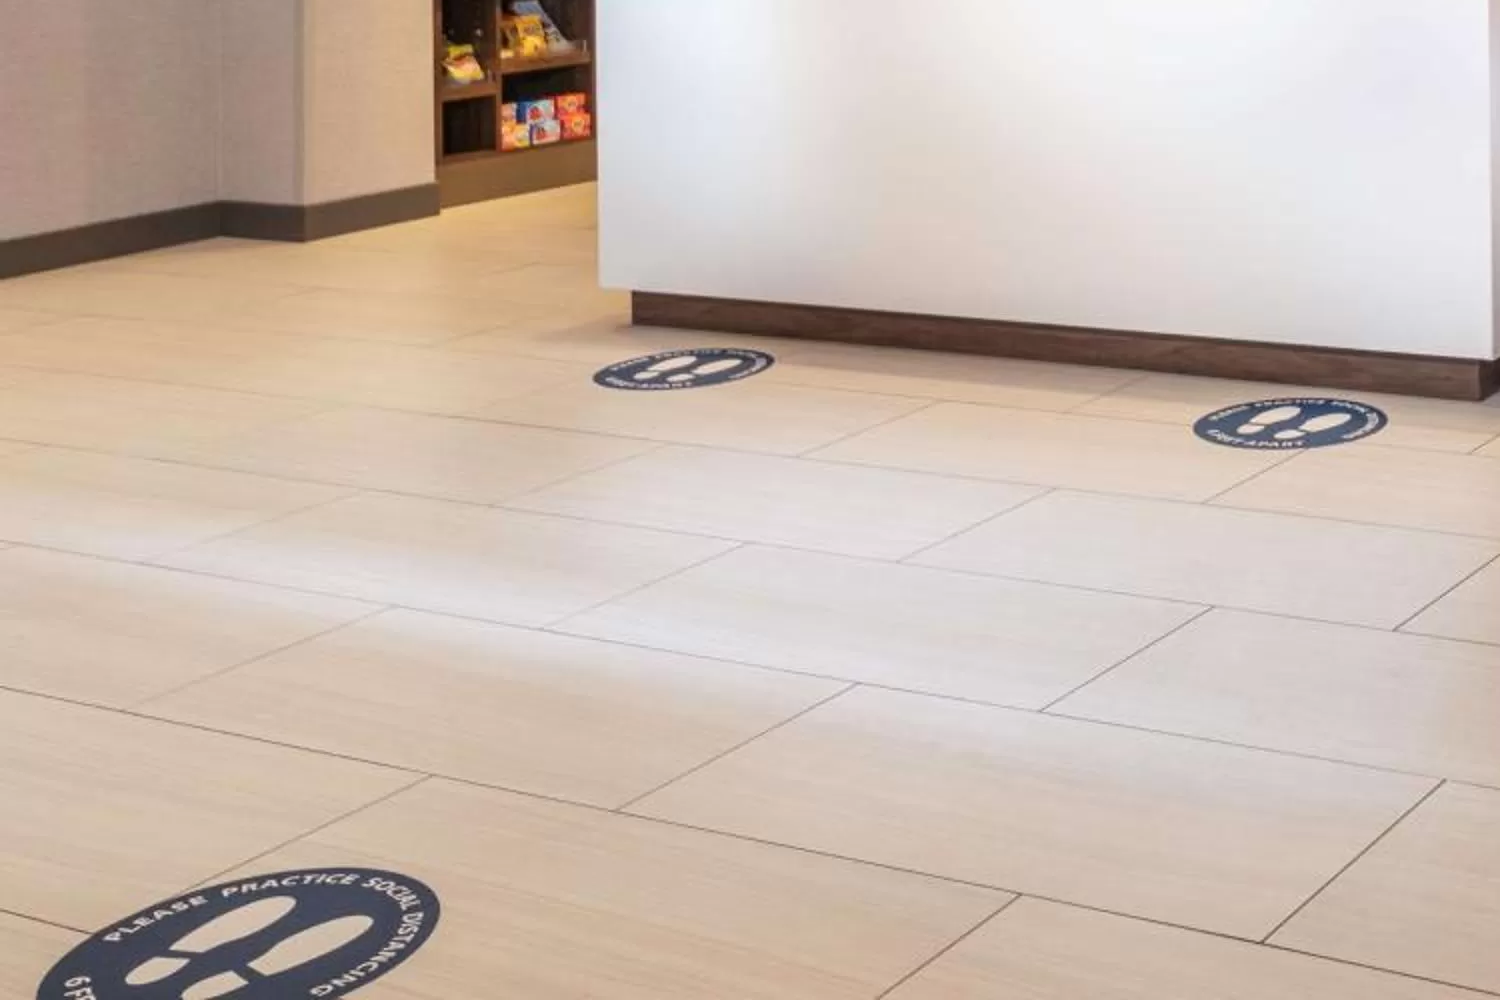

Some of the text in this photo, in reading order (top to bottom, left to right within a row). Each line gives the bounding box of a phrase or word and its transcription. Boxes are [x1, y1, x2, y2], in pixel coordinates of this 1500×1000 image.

[102, 873, 424, 997] PLEASE PRACTICE SOCIAL DISTANCING
